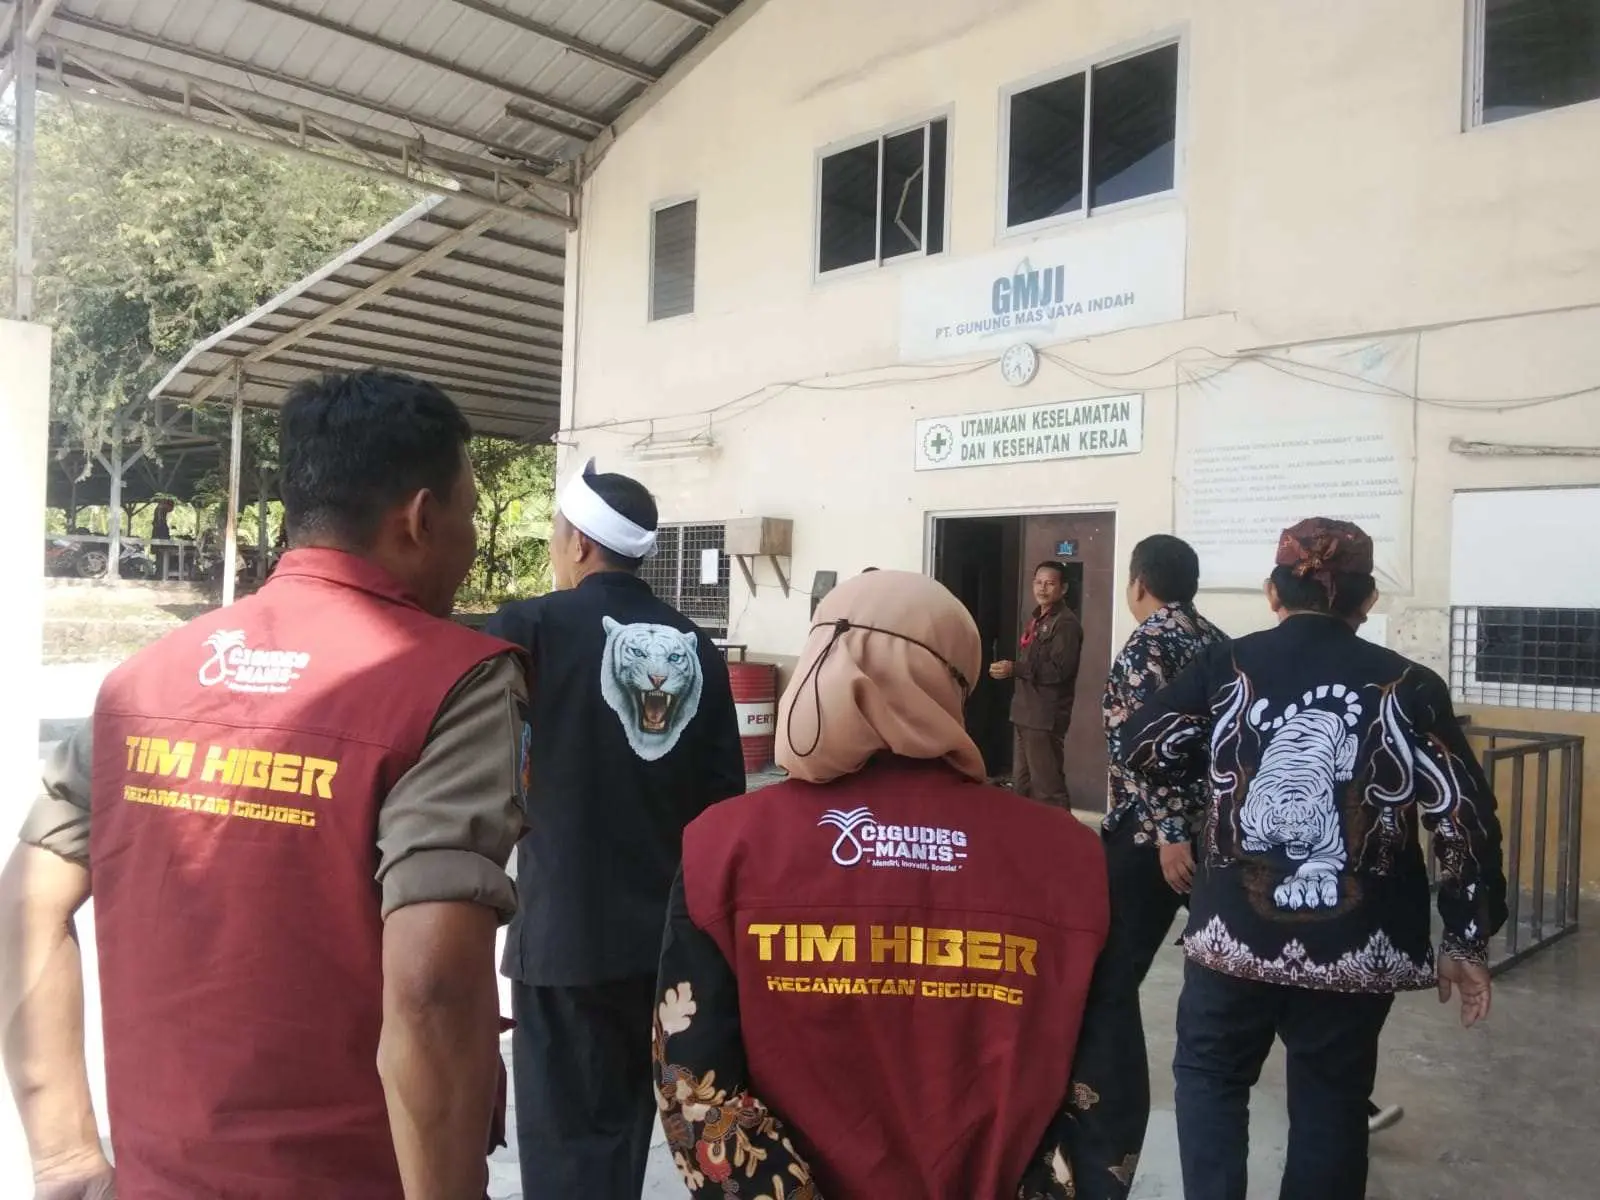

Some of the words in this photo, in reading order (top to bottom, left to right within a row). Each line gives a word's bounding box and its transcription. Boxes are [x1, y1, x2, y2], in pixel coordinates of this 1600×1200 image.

[991, 264, 1065, 316] GMJI
[935, 325, 953, 339] PT.
[956, 315, 1011, 336] GUNUNG
[1015, 308, 1044, 325] MAS
[1048, 302, 1083, 320] JAYA
[1088, 292, 1135, 313] INDAH
[961, 413, 1027, 438] UTAMAKAN
[1032, 401, 1130, 430] KESELAMATAN
[961, 442, 985, 461] DAN
[993, 433, 1070, 458] KESEHATAN
[1079, 428, 1129, 450] KERJA
[125, 735, 197, 779] TIM
[200, 745, 338, 799] HIBER
[231, 800, 316, 827] CIGUDEG
[861, 824, 967, 847] CIGUDEG
[875, 841, 954, 862] MANIS
[748, 924, 856, 962] TIM
[870, 925, 1038, 977] HIBER
[766, 975, 916, 996] KECAMATAN
[921, 981, 1024, 1006] CIGUDEG
